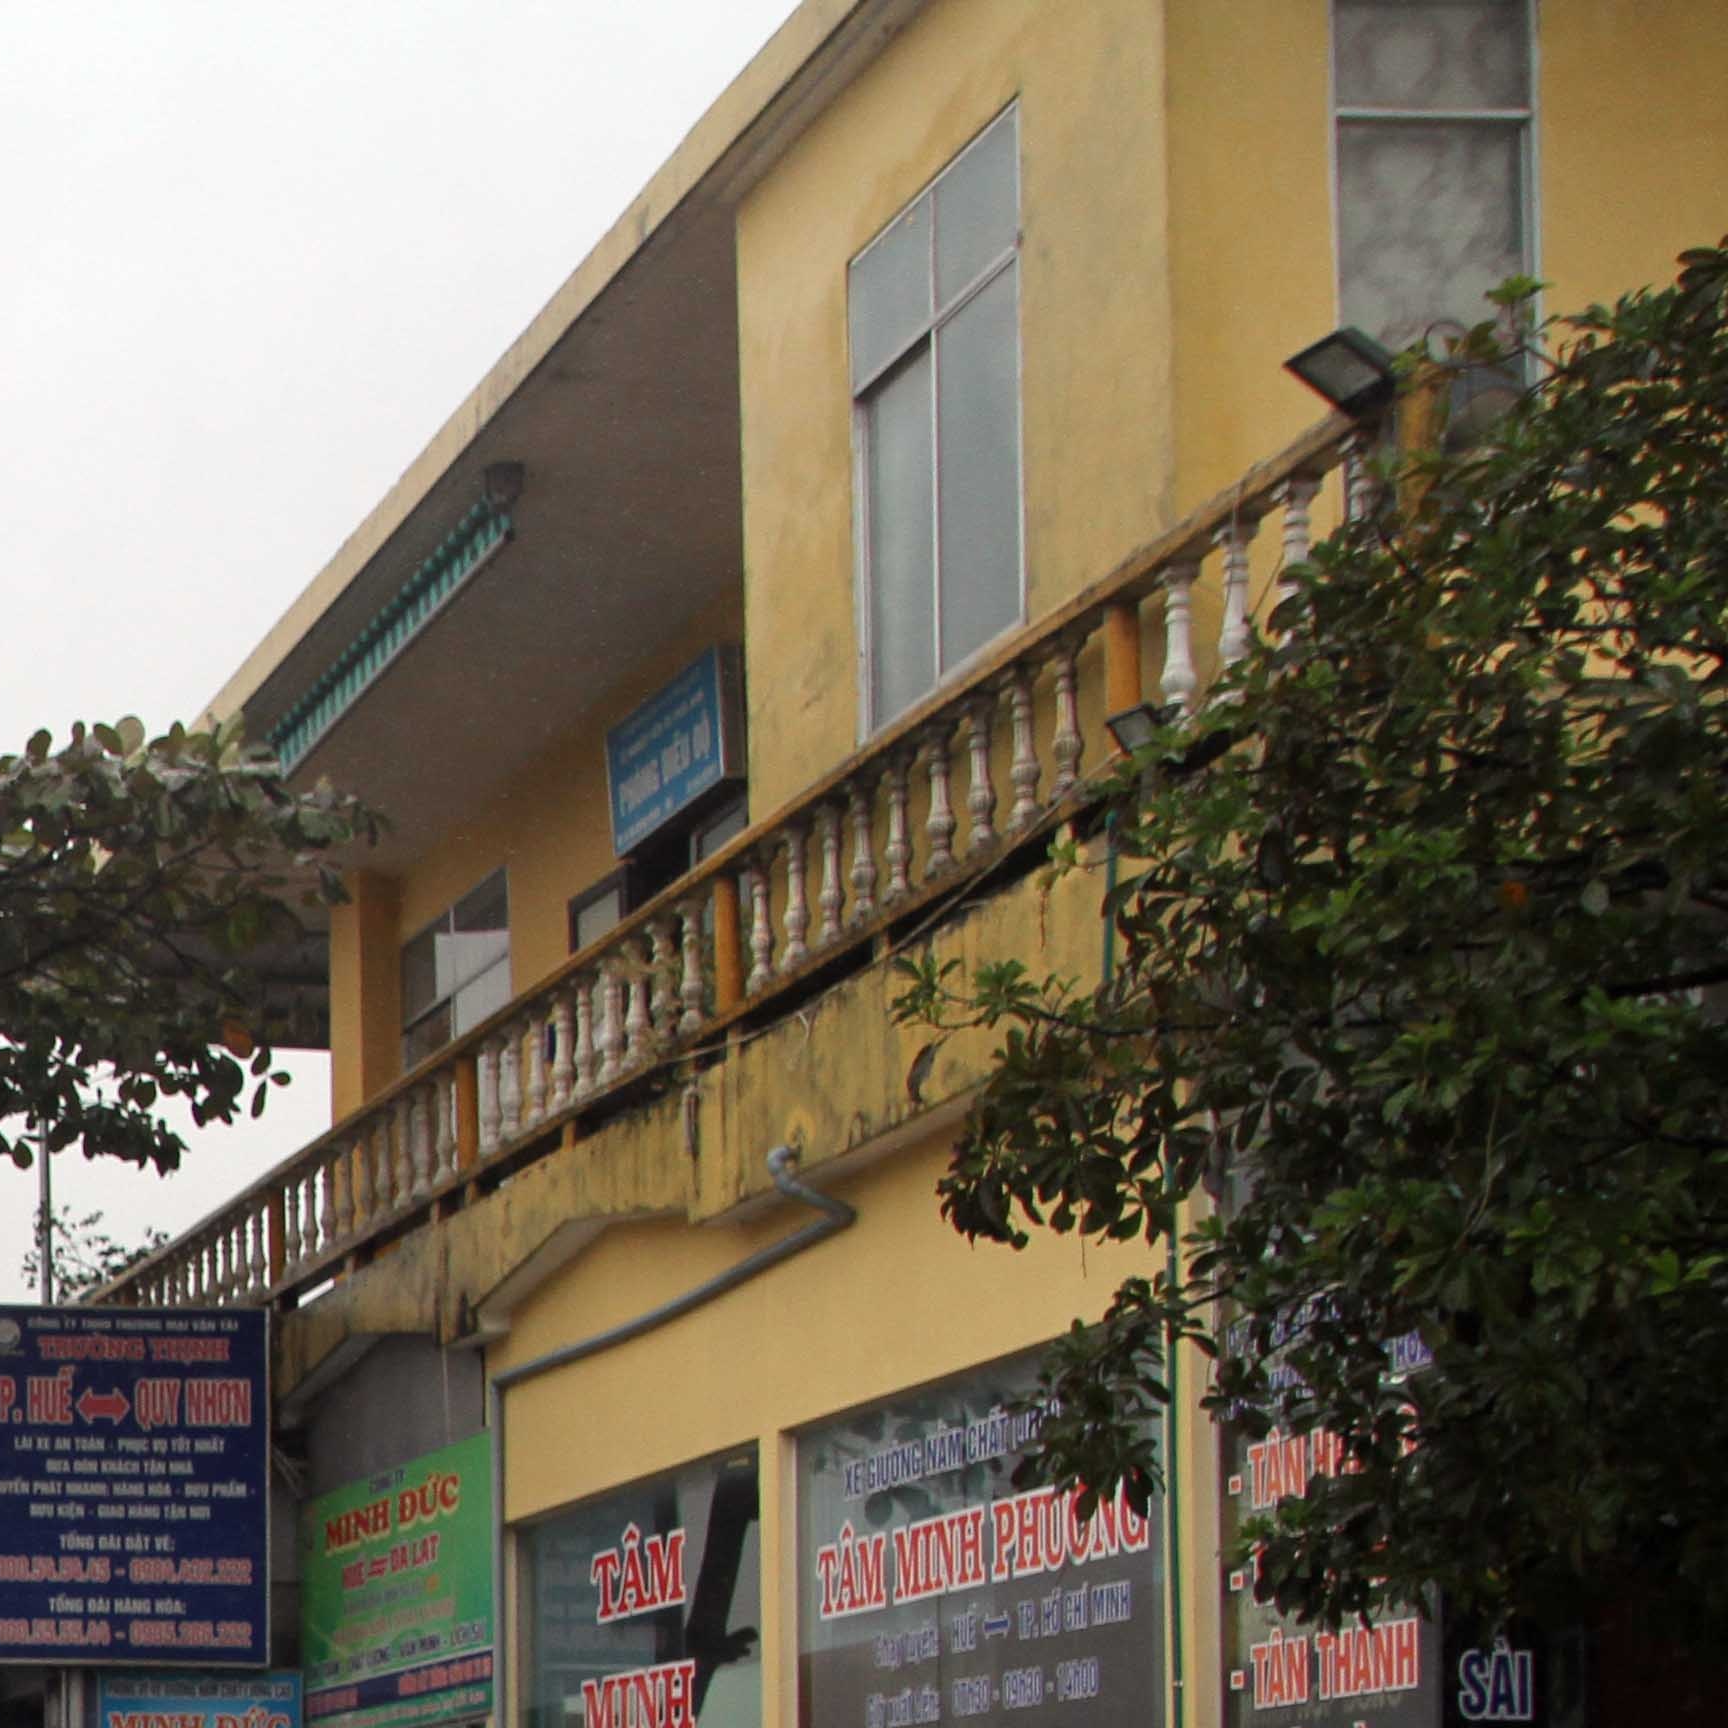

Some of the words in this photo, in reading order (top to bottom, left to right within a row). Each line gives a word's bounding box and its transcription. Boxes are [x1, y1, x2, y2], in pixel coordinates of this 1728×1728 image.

[149, 1335, 231, 1366] THỊNH
[27, 1364, 77, 1424] HUẾ
[134, 1377, 181, 1432] QUY
[185, 1378, 253, 1427] NHƠN
[843, 1462, 863, 1499] XE
[865, 1438, 922, 1491] GIƯỜNG
[924, 1417, 964, 1477] NẰM
[965, 1405, 1009, 1466] CHẤT
[1247, 1430, 1308, 1510] TÂN
[324, 1497, 392, 1557] MINH
[396, 1471, 461, 1532] ĐỨC
[591, 1523, 686, 1625] TÂM
[816, 1519, 887, 1620] TÂM
[892, 1504, 986, 1605] MINH
[951, 1602, 977, 1653] HUẾ
[1041, 1587, 1062, 1638] HỒ
[1063, 1579, 1090, 1633] CHÍ
[1091, 1579, 1132, 1626] MINH
[1250, 1630, 1308, 1710] TÂN
[1315, 1613, 1419, 1699] THÀNH
[1459, 1635, 1535, 1721] SÀI
